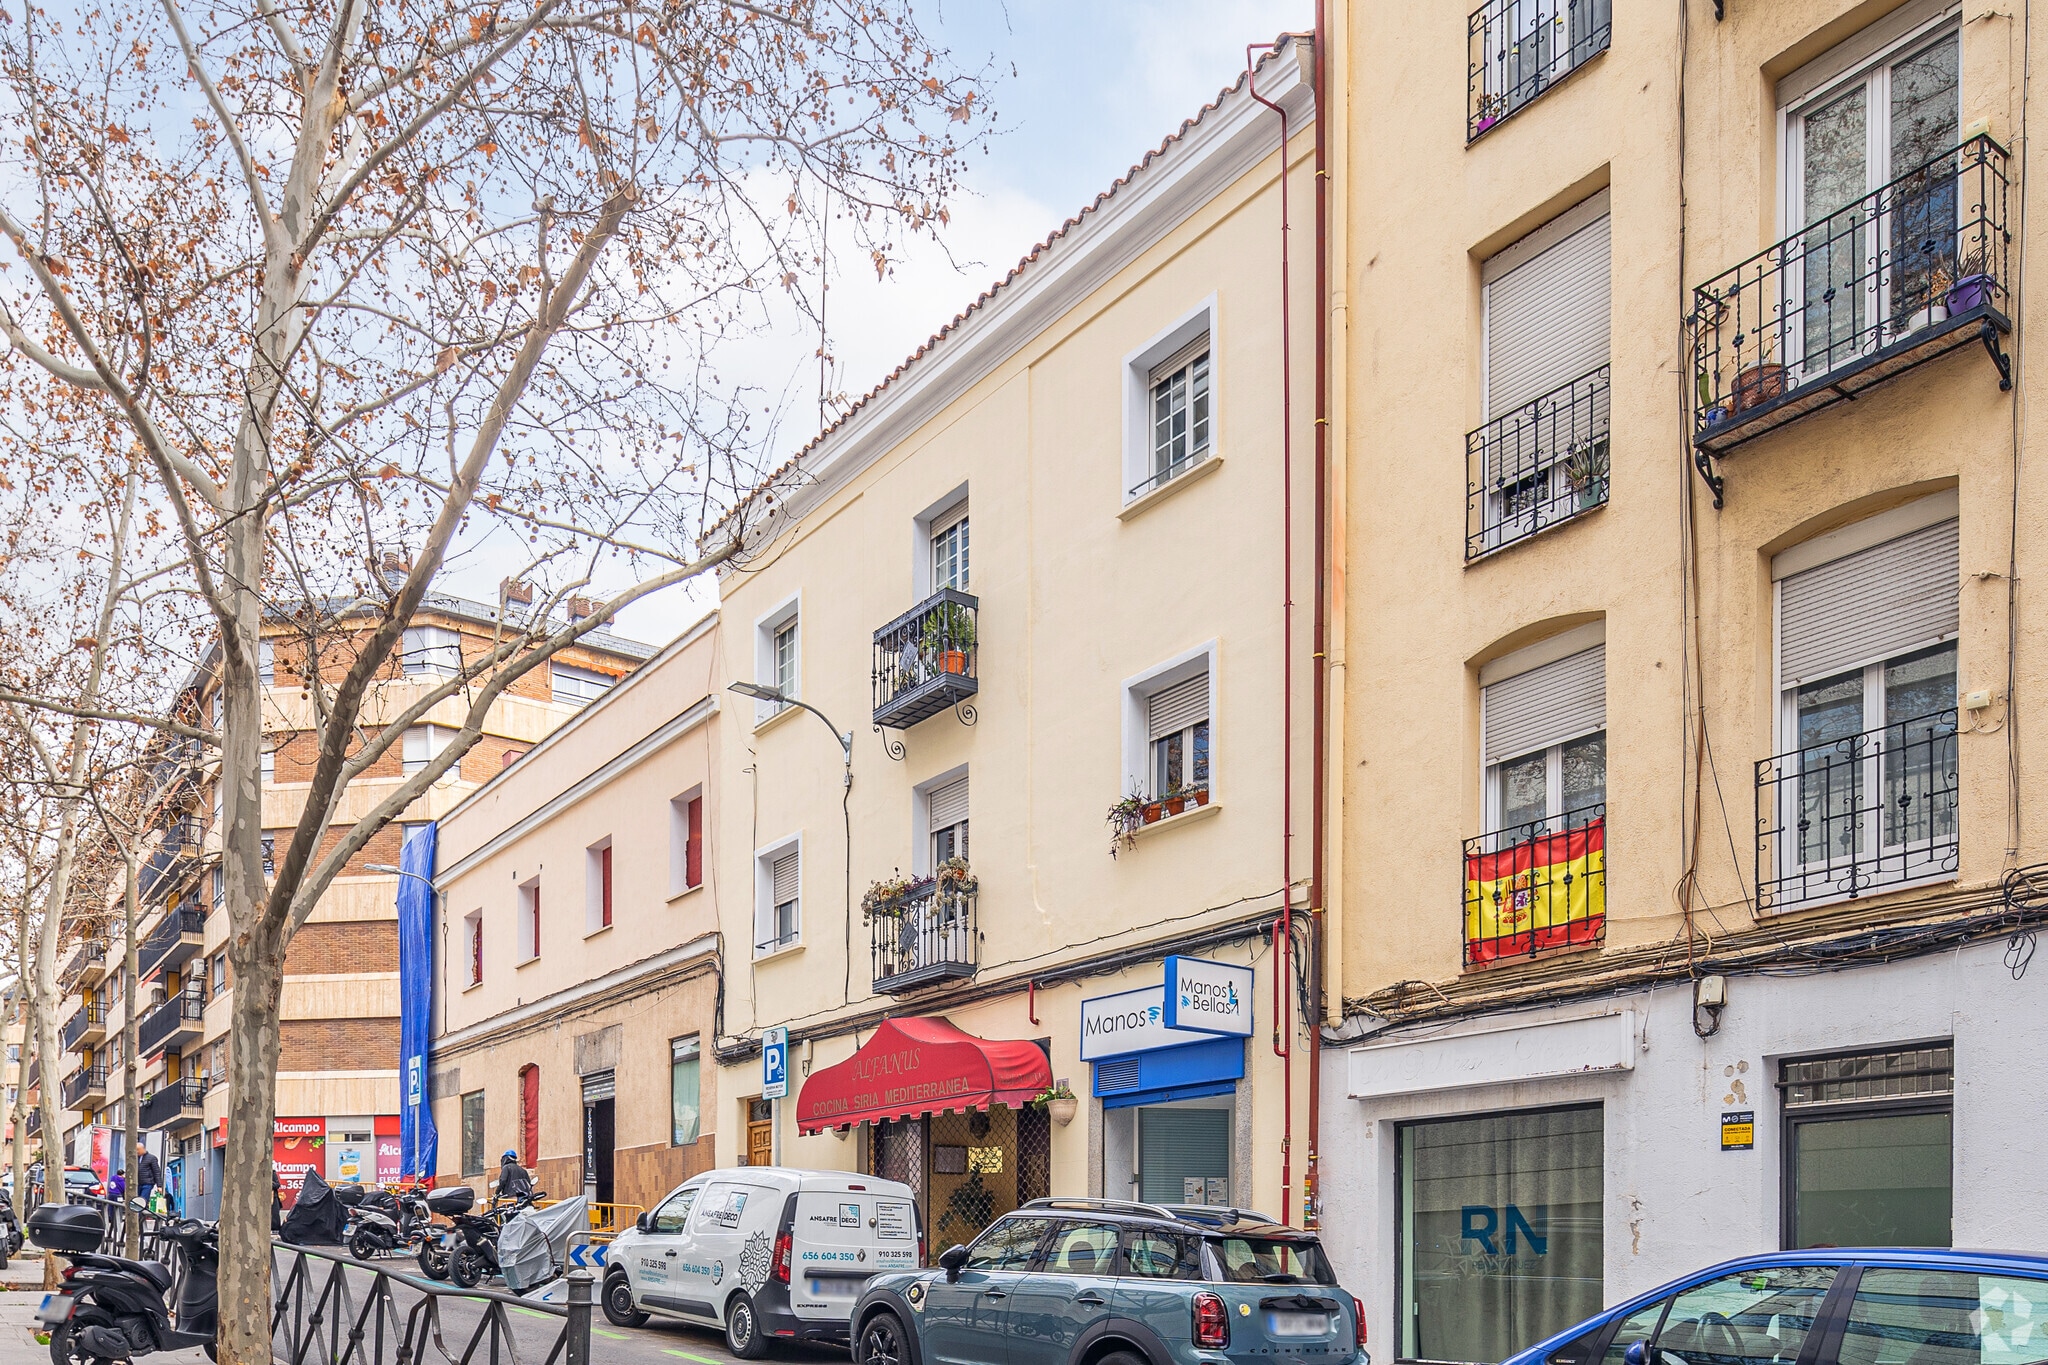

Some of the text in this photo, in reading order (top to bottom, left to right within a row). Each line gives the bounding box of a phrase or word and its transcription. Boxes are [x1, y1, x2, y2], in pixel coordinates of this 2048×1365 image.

[1180, 977, 1227, 998] Manos
[1192, 995, 1232, 1015] Bellas
[1085, 1010, 1146, 1037] Manos
[766, 1048, 780, 1081] P
[852, 1048, 921, 1081] ALFANUS
[410, 1070, 418, 1094] P
[812, 1077, 970, 1116] COCINA SIRIA MEDITERRANEA
[378, 1143, 401, 1156] Alc
[378, 1167, 388, 1175] LA
[701, 1209, 739, 1222] ANSAFRE DECO
[841, 1216, 858, 1224] DECO
[1461, 1203, 1547, 1255] RN
[802, 1251, 855, 1261] 656 604 350
[878, 1250, 890, 1258] 910
[890, 1250, 902, 1258] 325
[640, 1257, 649, 1267] 910
[649, 1259, 658, 1269] 325
[682, 1263, 692, 1273] 656
[692, 1264, 701, 1275] 604
[701, 1266, 711, 1276] 350
